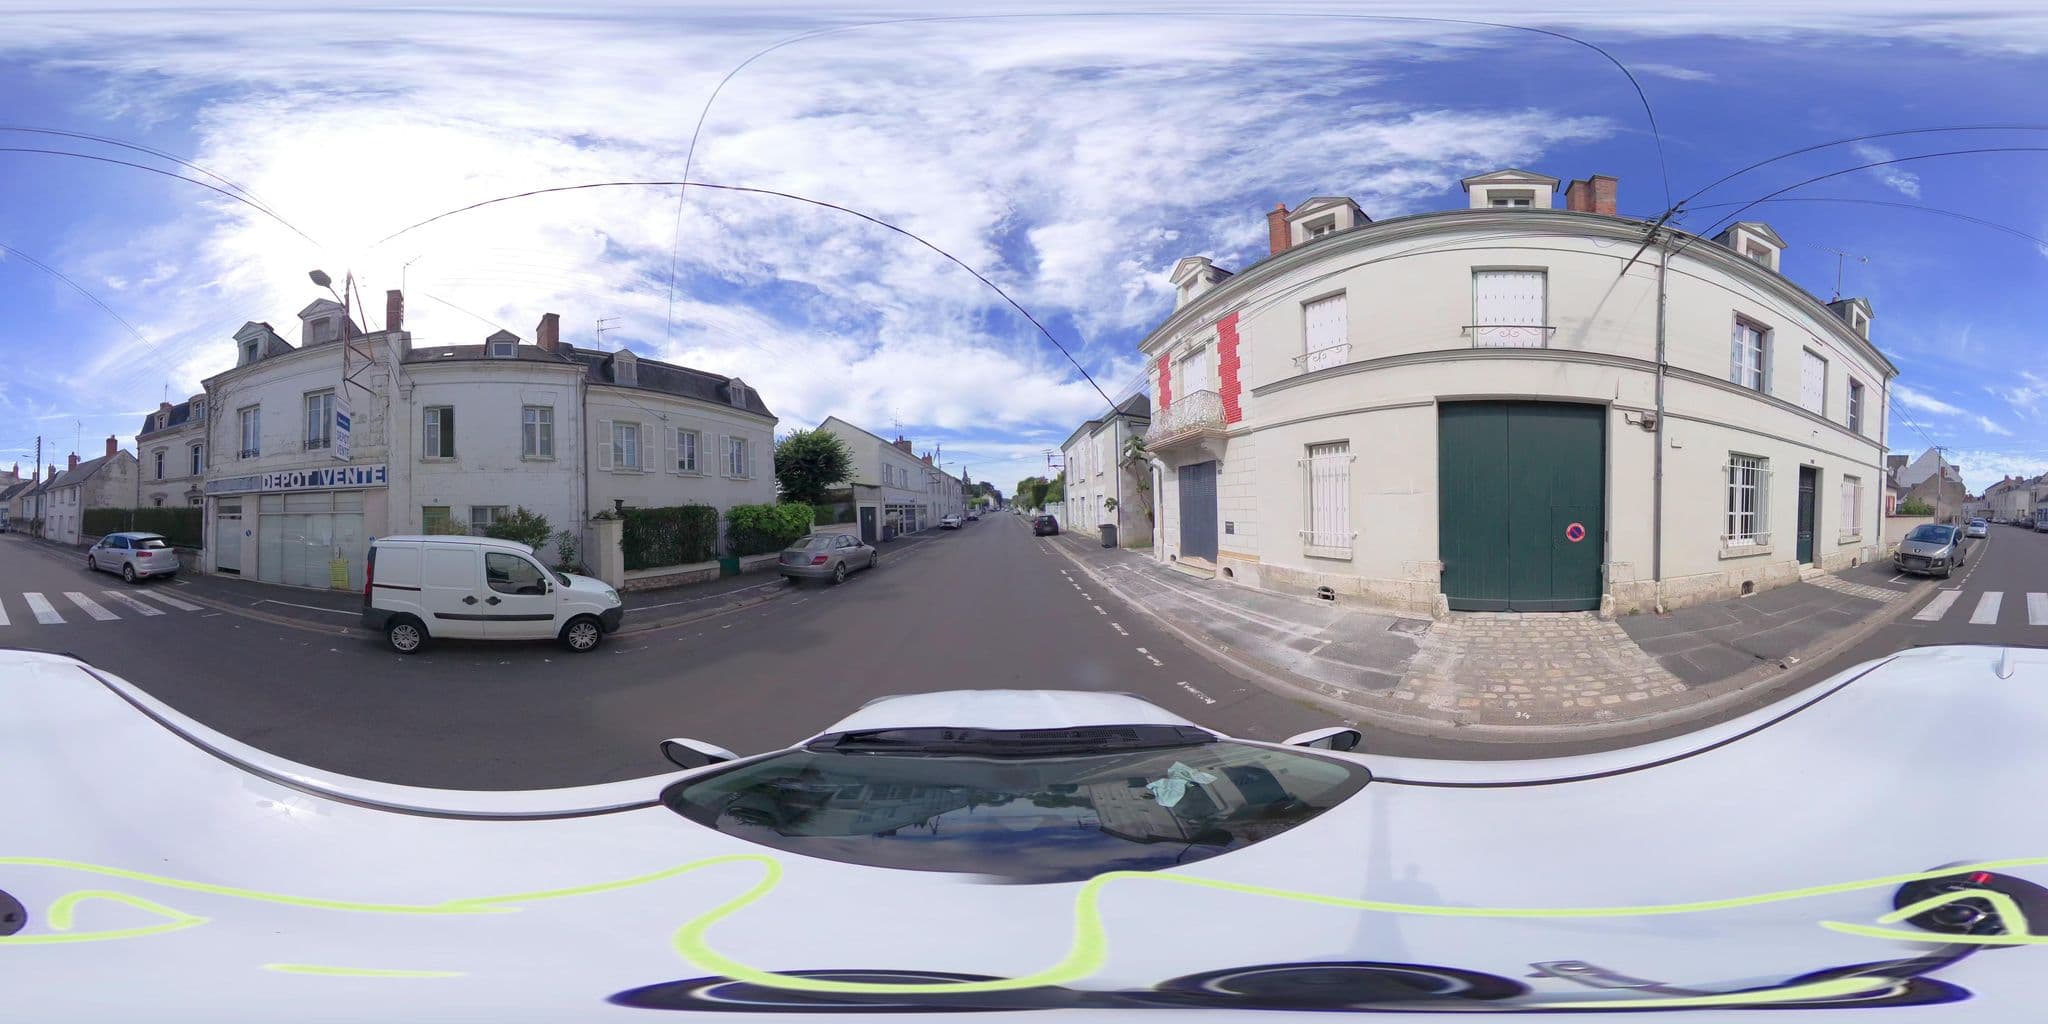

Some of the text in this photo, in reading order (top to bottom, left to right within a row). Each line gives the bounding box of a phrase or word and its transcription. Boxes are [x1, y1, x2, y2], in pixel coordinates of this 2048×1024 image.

[336, 431, 350, 447] DEPOT
[336, 444, 350, 459] VENTE
[262, 466, 386, 489] DEPOT VENTE
